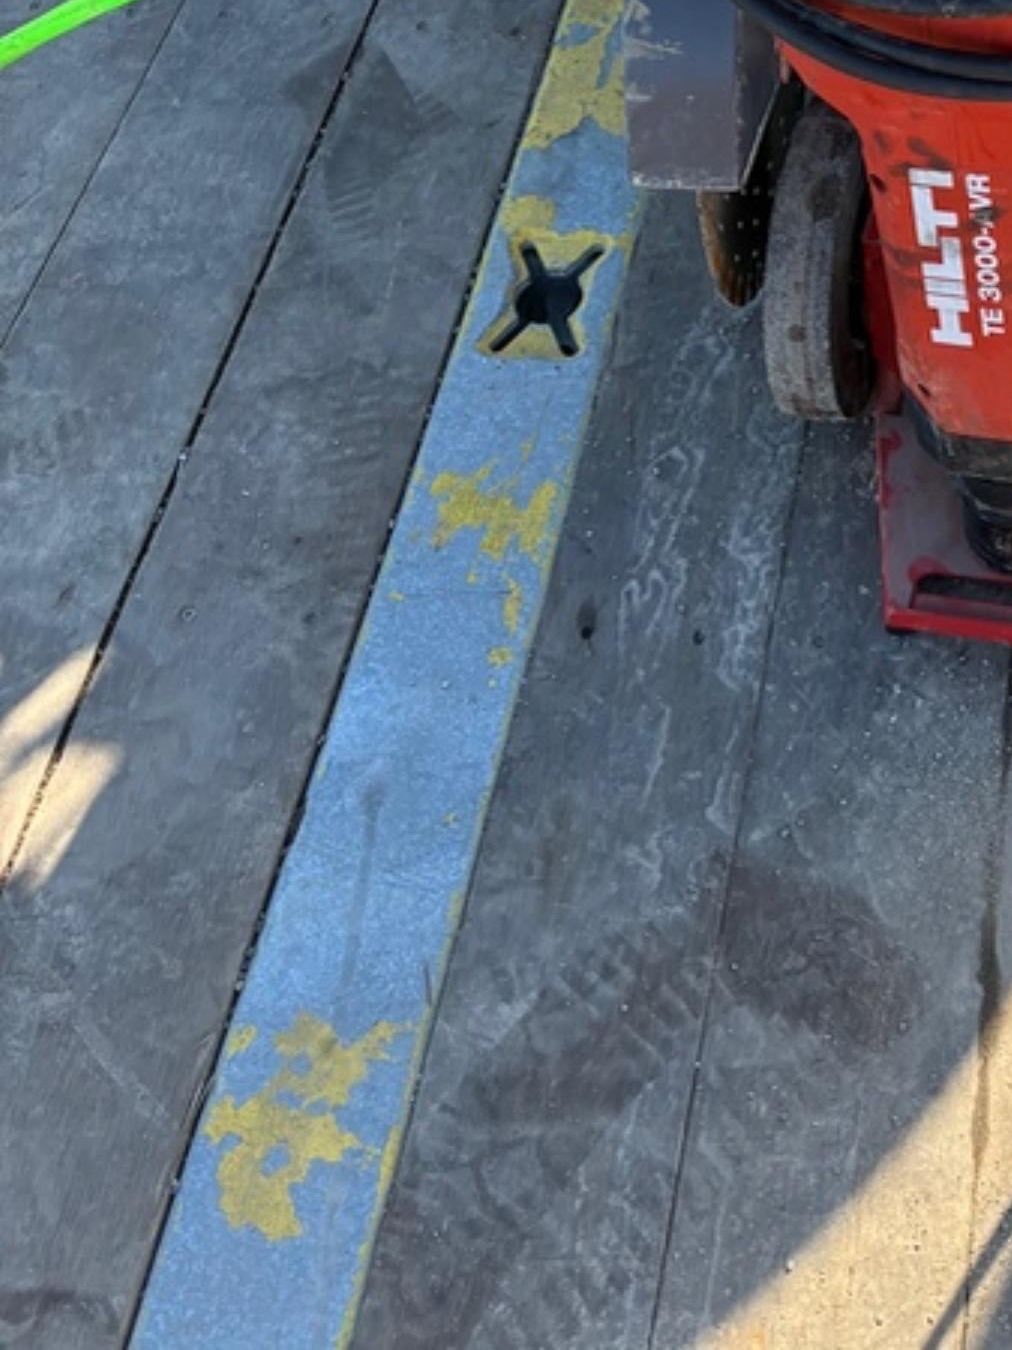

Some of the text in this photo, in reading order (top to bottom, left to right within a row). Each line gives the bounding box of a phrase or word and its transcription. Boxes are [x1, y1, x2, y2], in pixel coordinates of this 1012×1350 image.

[909, 167, 973, 346] HILTI
[965, 173, 1006, 337] TE 3000-AVR
